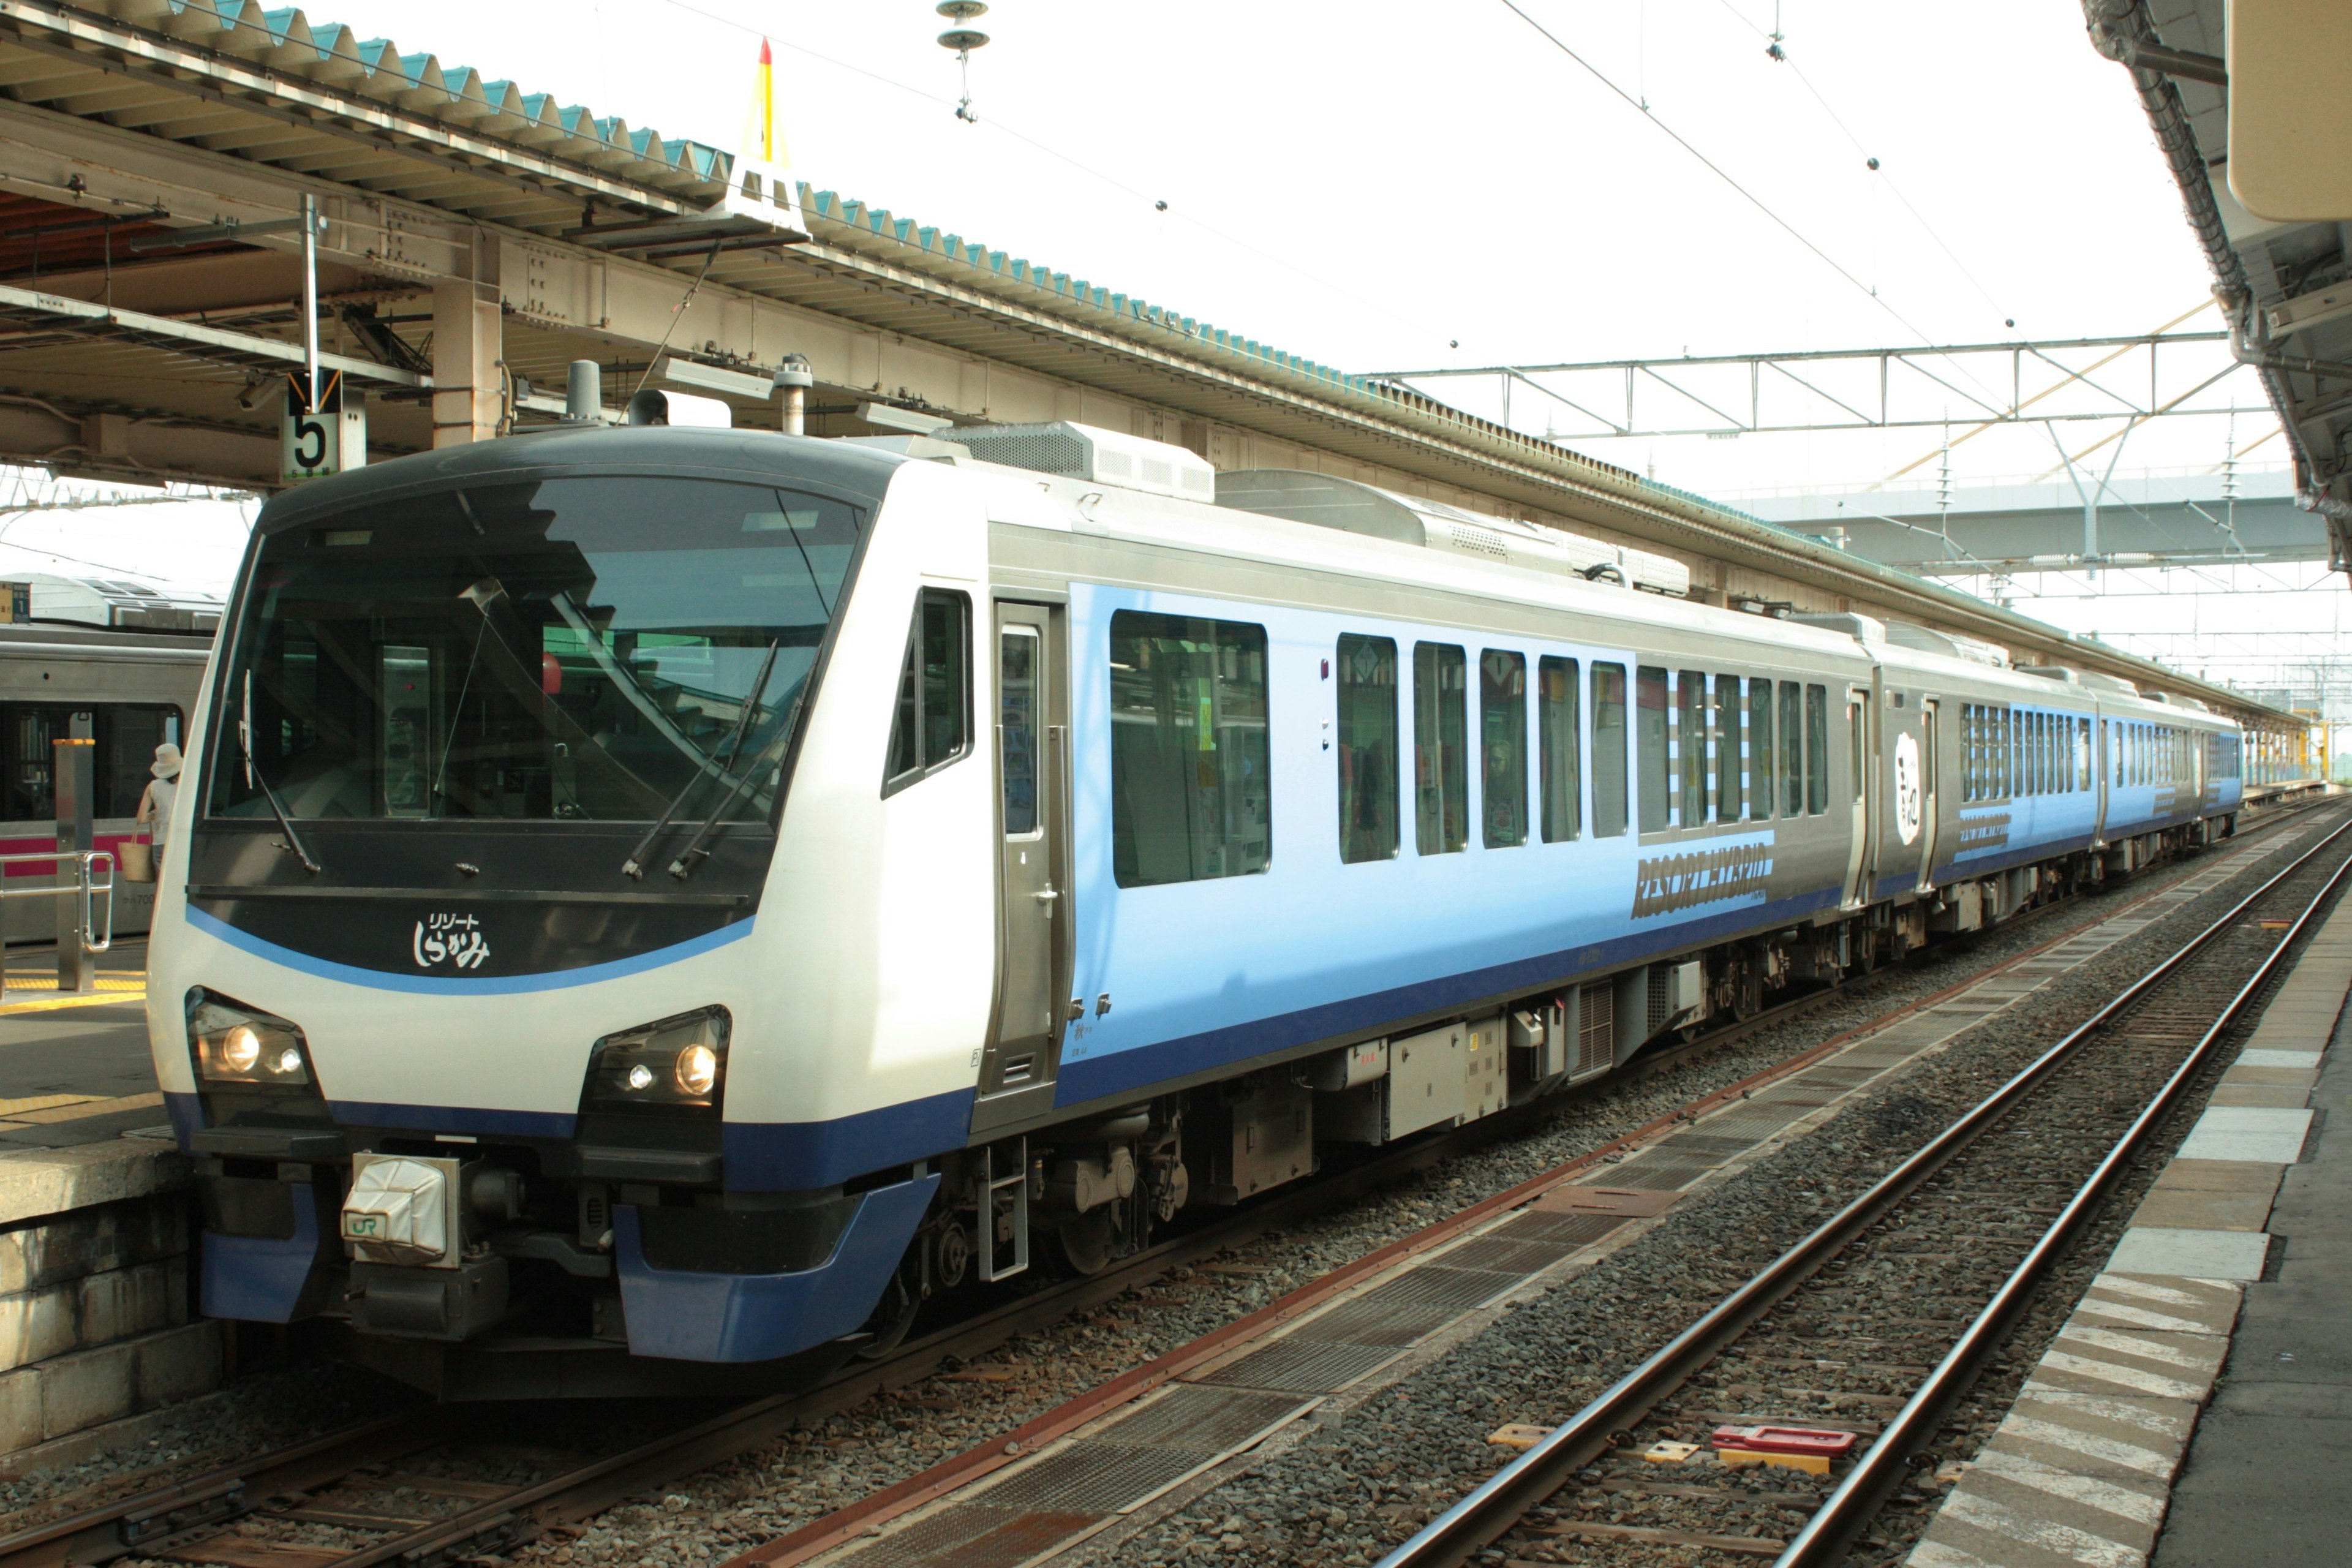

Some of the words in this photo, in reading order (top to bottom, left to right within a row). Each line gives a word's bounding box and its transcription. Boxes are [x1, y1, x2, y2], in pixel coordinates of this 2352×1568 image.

[295, 415, 326, 468] 5
[1630, 851, 1706, 920] RESORT
[1705, 842, 1766, 904] HYBRID
[413, 921, 490, 969] しらかみ
[429, 913, 479, 930] リゾート
[353, 1218, 377, 1235] JR
